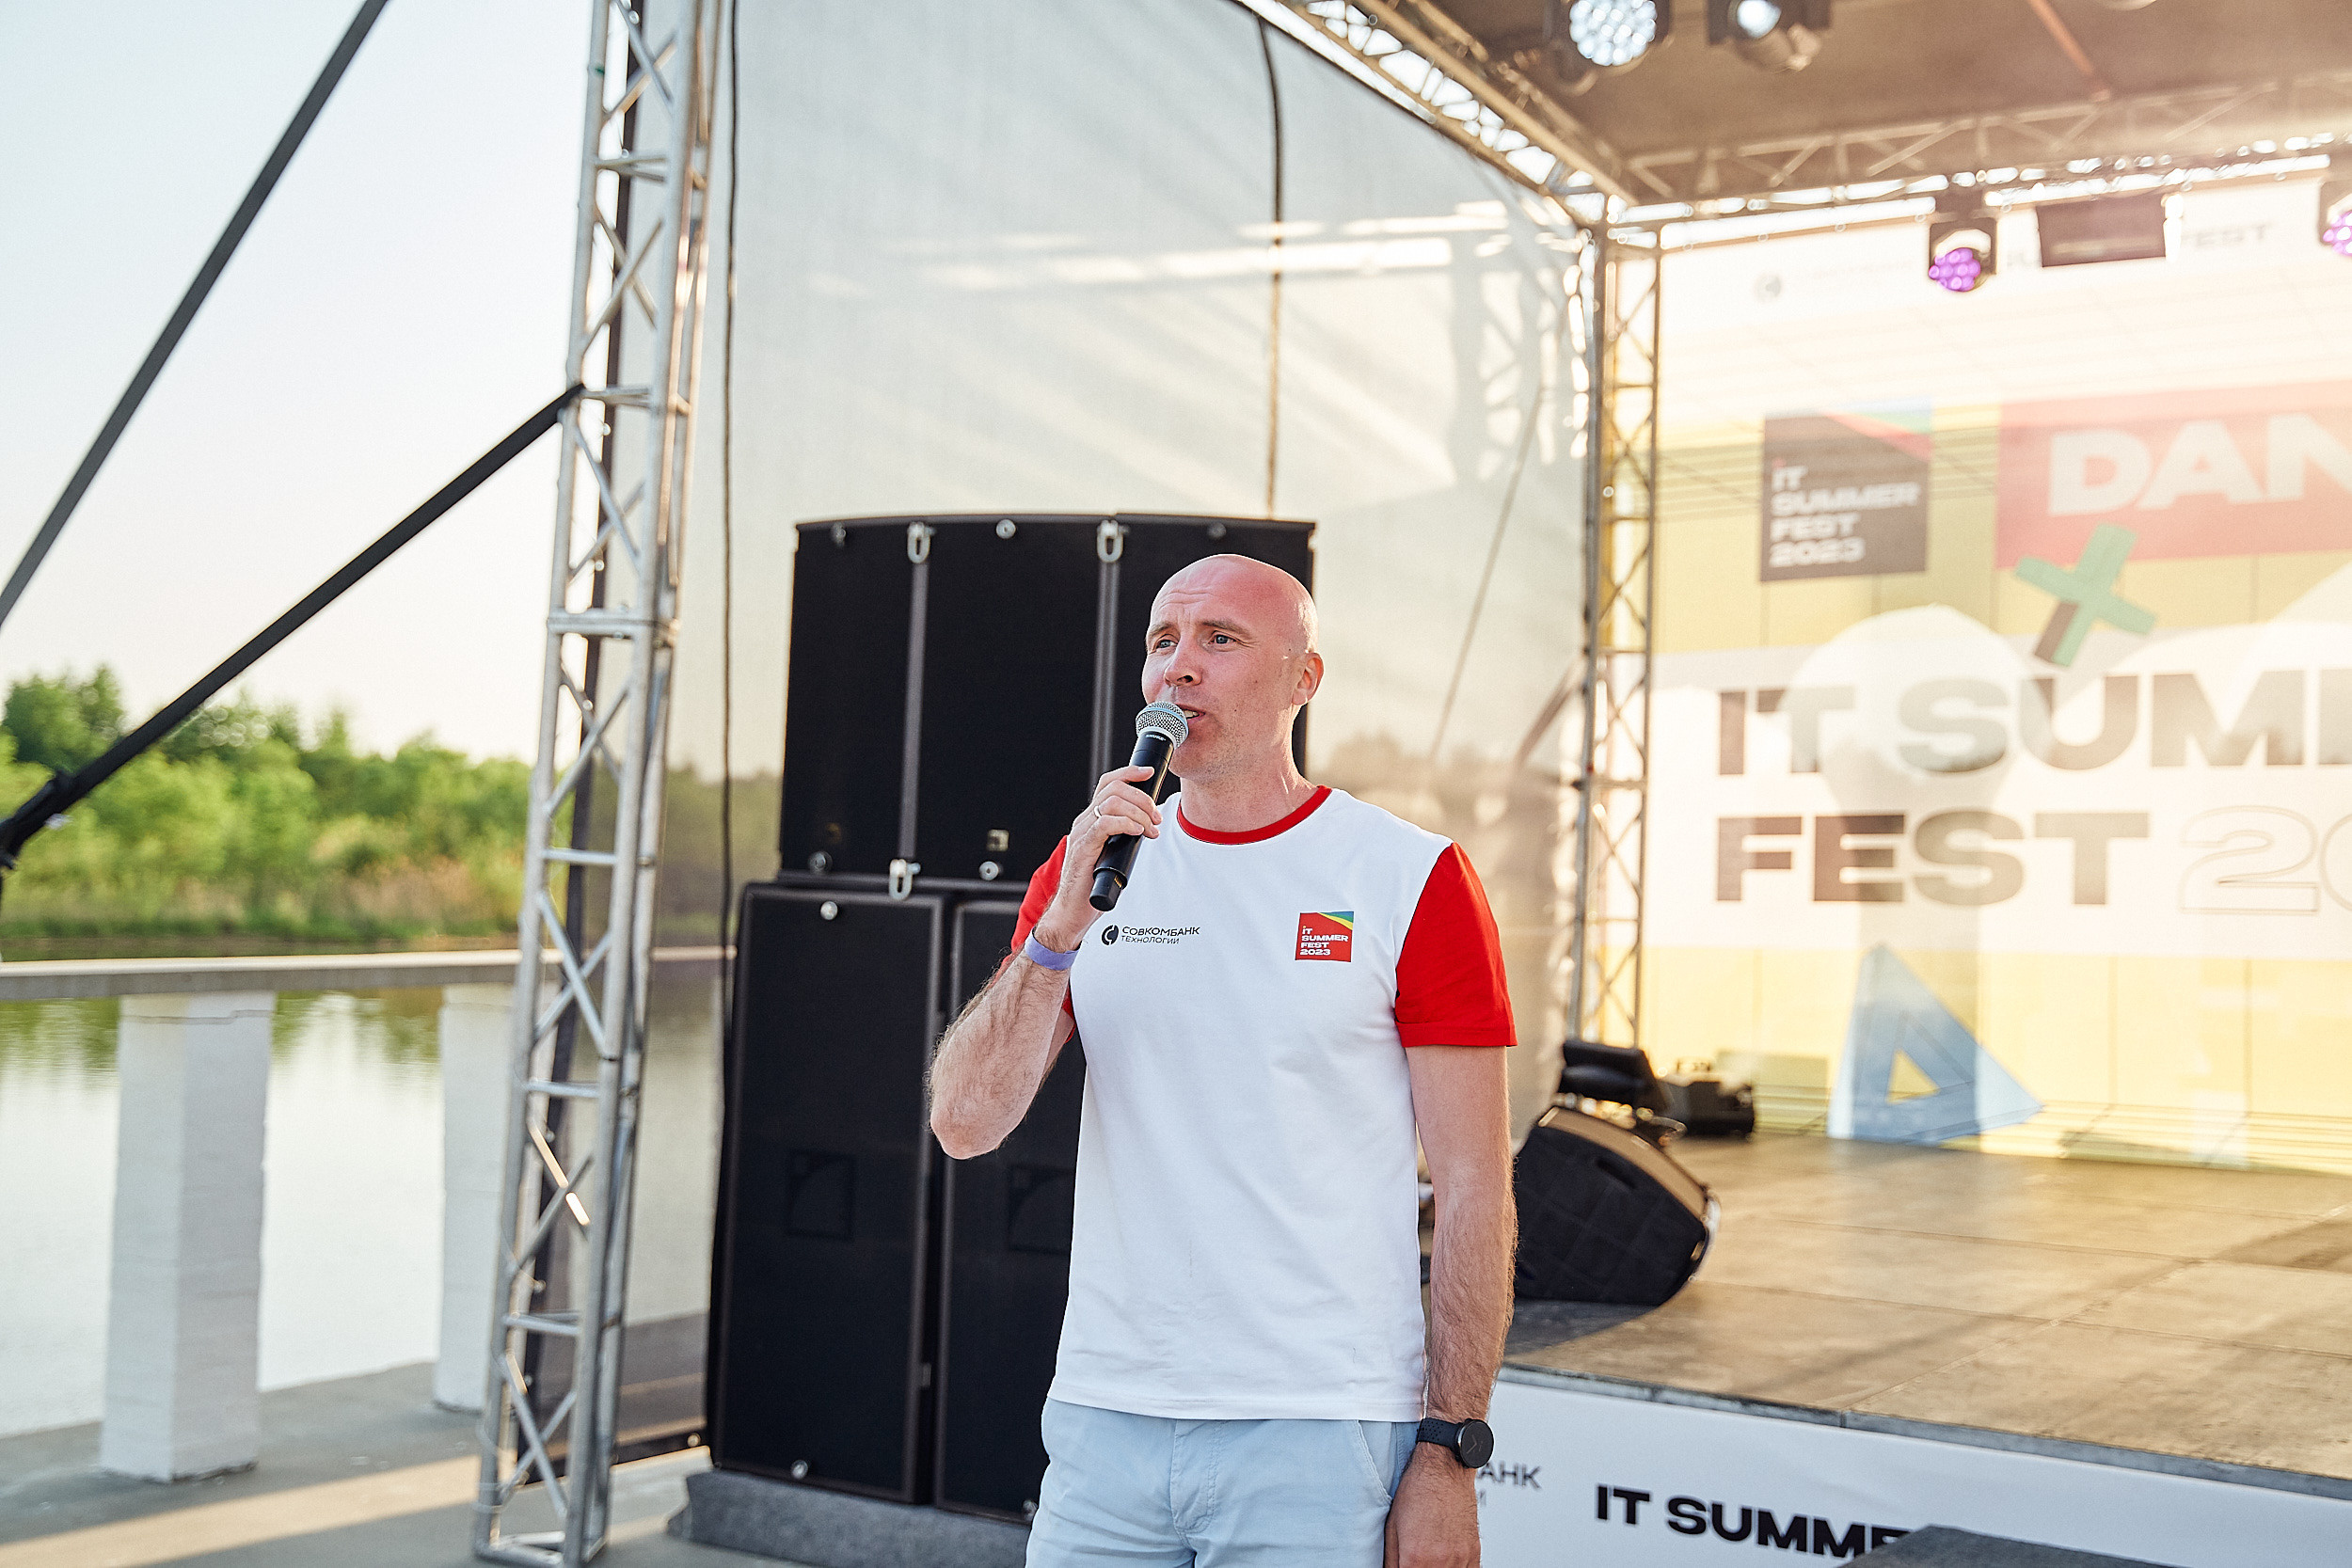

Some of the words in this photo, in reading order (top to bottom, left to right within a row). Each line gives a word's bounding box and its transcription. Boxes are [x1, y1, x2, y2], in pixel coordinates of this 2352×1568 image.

[2048, 412, 2352, 515] DAN
[1771, 482, 1921, 517] SUMMER
[1771, 512, 1860, 541] FEST
[1769, 536, 1867, 568] 2023
[1718, 686, 1856, 775] IT
[1897, 668, 2352, 774] SUM
[1715, 809, 2149, 907] FEST
[2176, 804, 2352, 915] 2
[1120, 935, 1180, 944] ТЕХНОЛОГИИ
[1121, 926, 1201, 937] СОВКОМБАНК
[1301, 934, 1349, 942] SUMMER
[1597, 1484, 1650, 1525] IT
